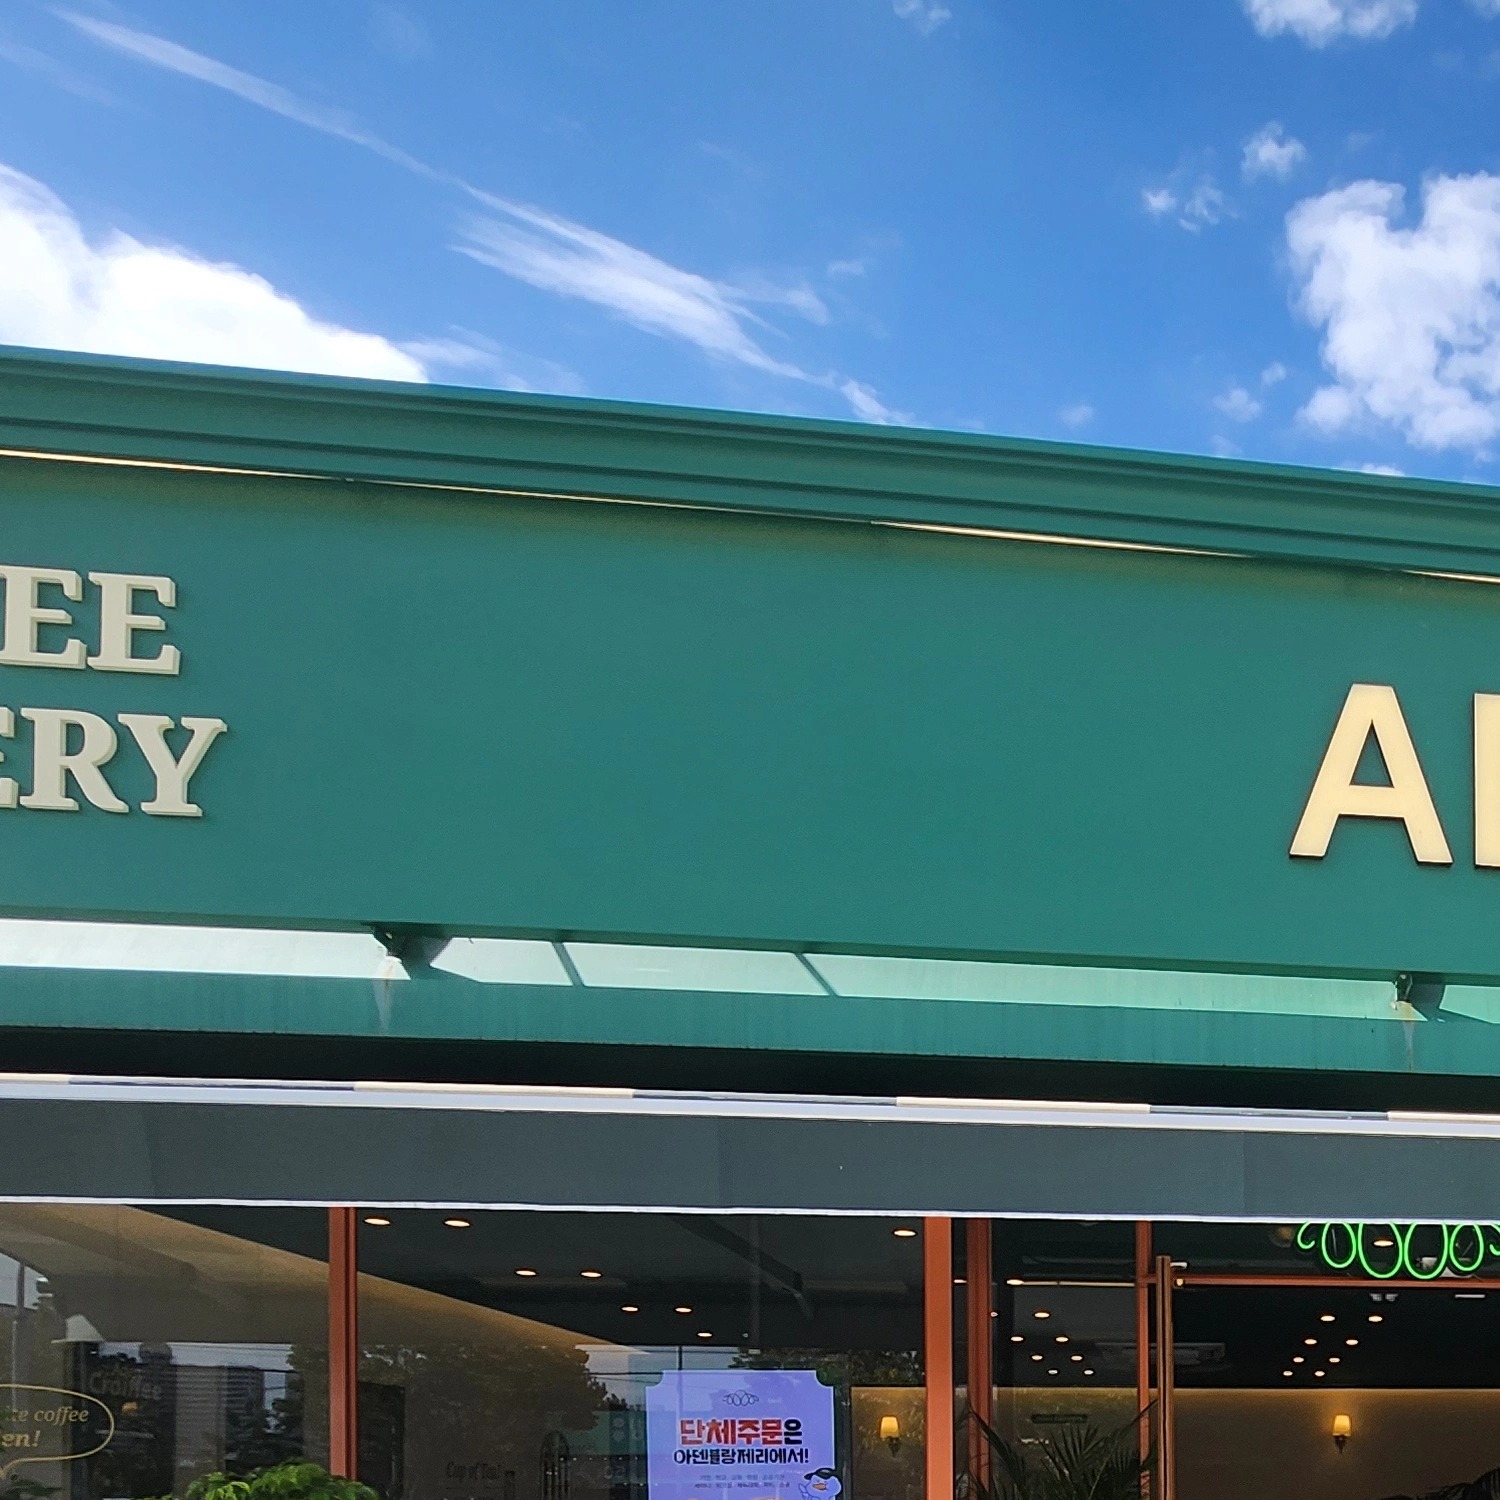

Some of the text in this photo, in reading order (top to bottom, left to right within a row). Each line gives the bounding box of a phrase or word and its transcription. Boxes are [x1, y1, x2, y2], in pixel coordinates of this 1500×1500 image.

[0, 706, 228, 817] RY
[34, 1406, 89, 1425] coffee
[679, 1419, 803, 1446] 단체주문은
[673, 1448, 810, 1466] 아덴블랑제리에서!
